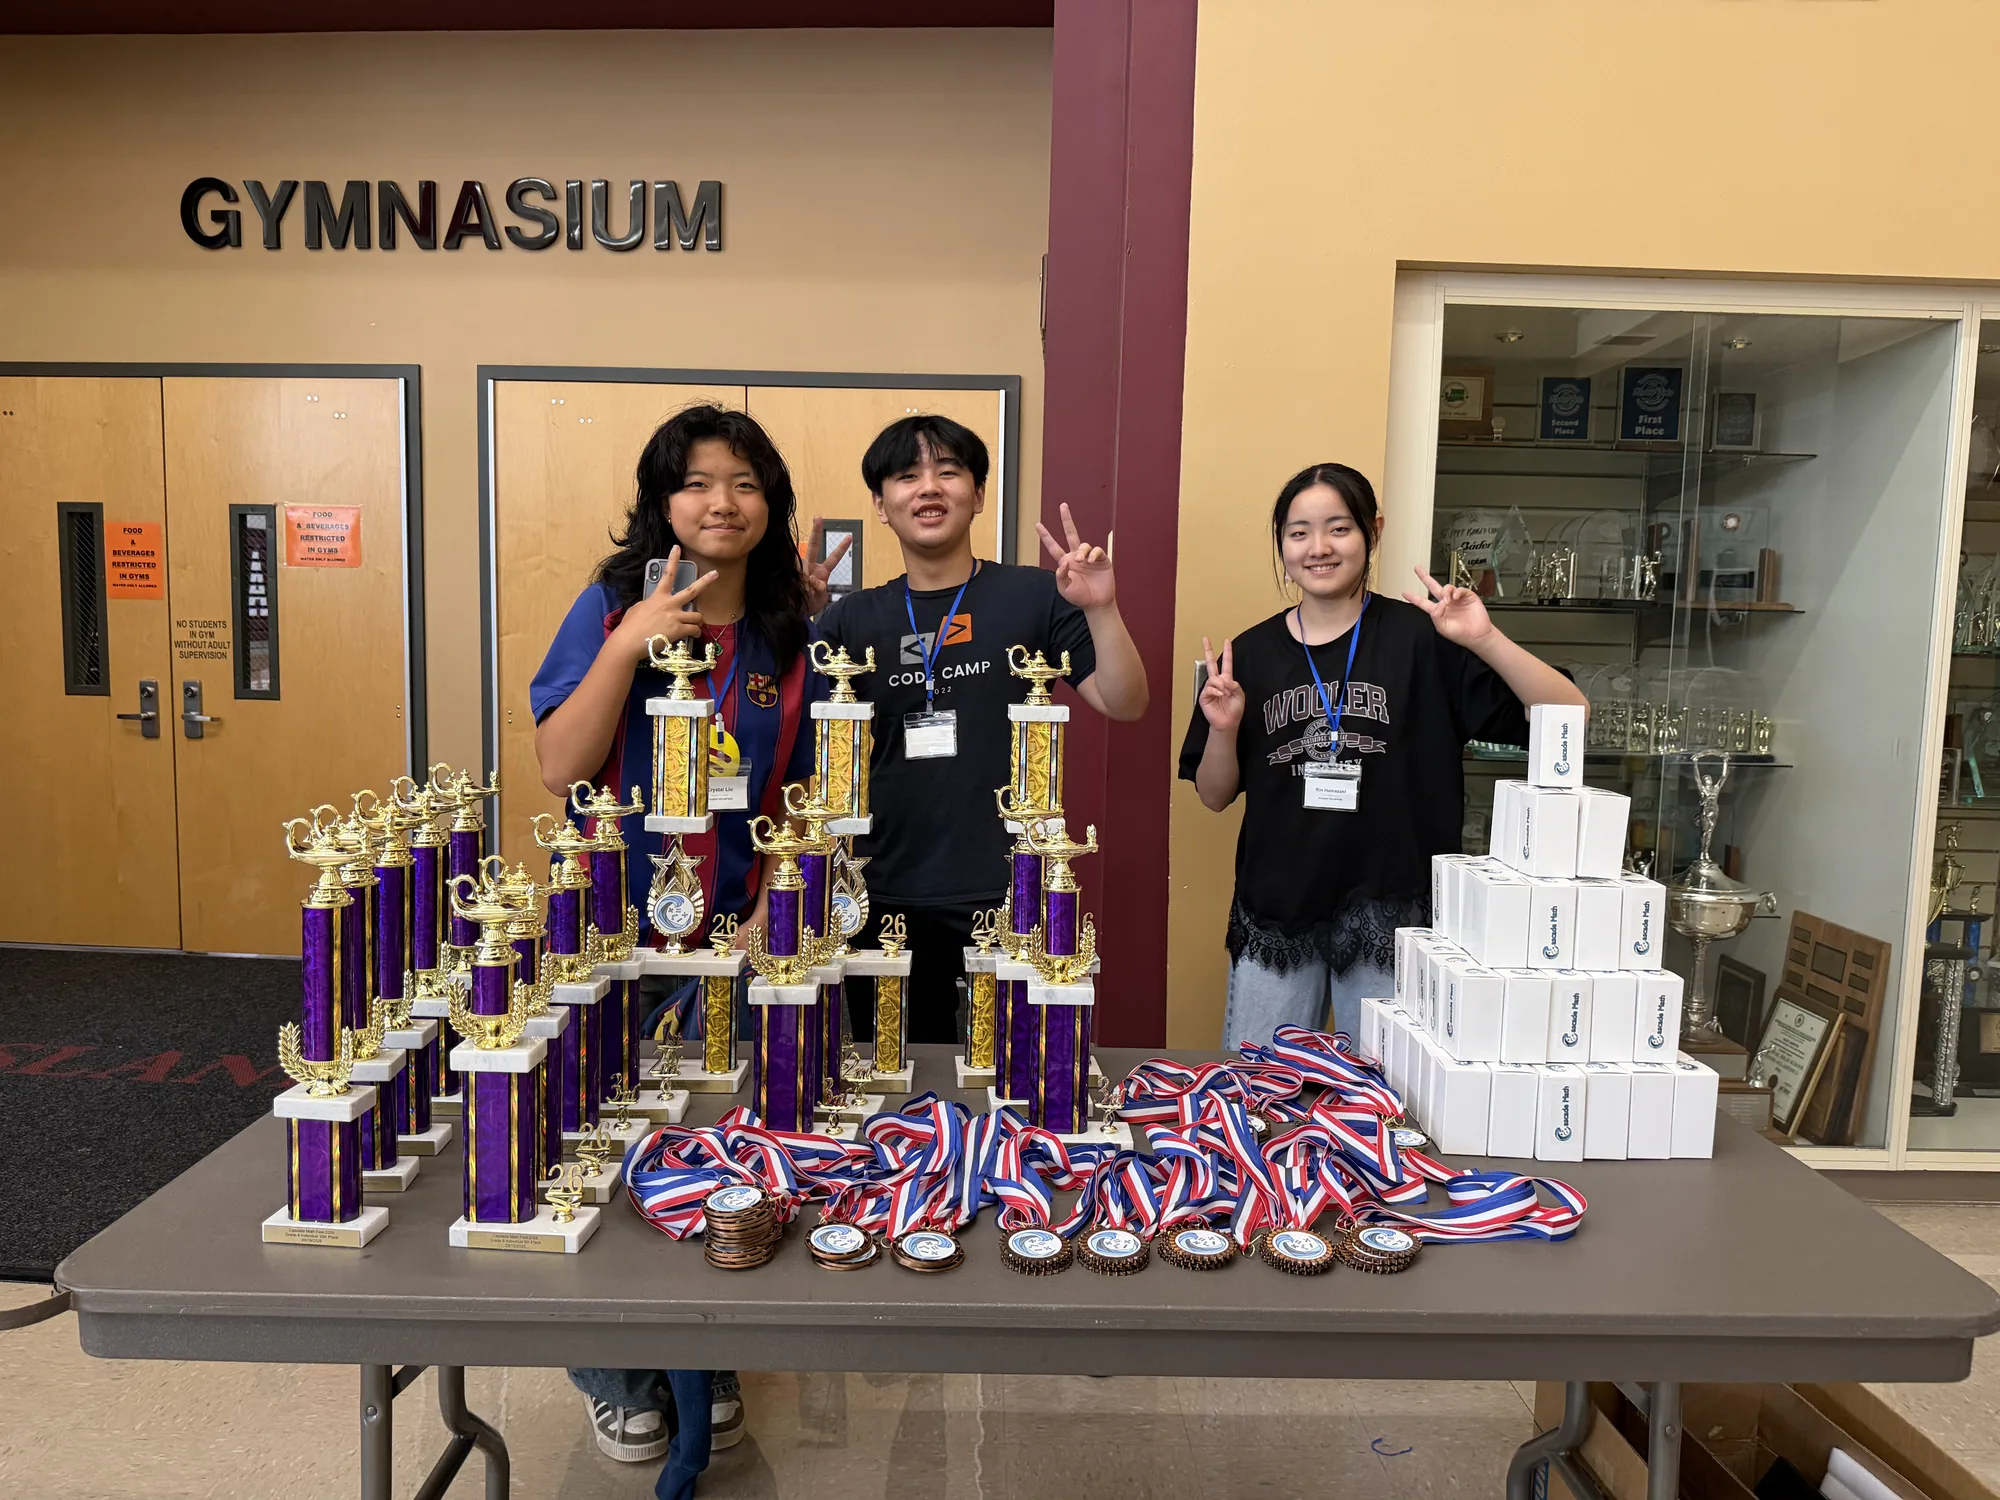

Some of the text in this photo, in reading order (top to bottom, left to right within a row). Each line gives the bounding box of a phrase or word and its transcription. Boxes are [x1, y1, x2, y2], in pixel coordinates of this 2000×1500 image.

[180, 176, 723, 251] GYMNASIUM
[1551, 419, 1579, 427] Second
[1638, 415, 1662, 424] First
[1554, 427, 1575, 435] Place
[1635, 425, 1664, 435] Place
[176, 619, 227, 629] NO STUDENTS
[189, 630, 215, 639] IN GYM
[174, 640, 231, 649] WITHOUT ADULT
[179, 650, 228, 660] SUPERVISION
[942, 661, 991, 680] CAMP
[1263, 680, 1390, 736] WOOLER
[712, 913, 739, 936] 26
[880, 913, 907, 936] 26
[577, 1120, 611, 1149] 26
[548, 1163, 584, 1193] 26
